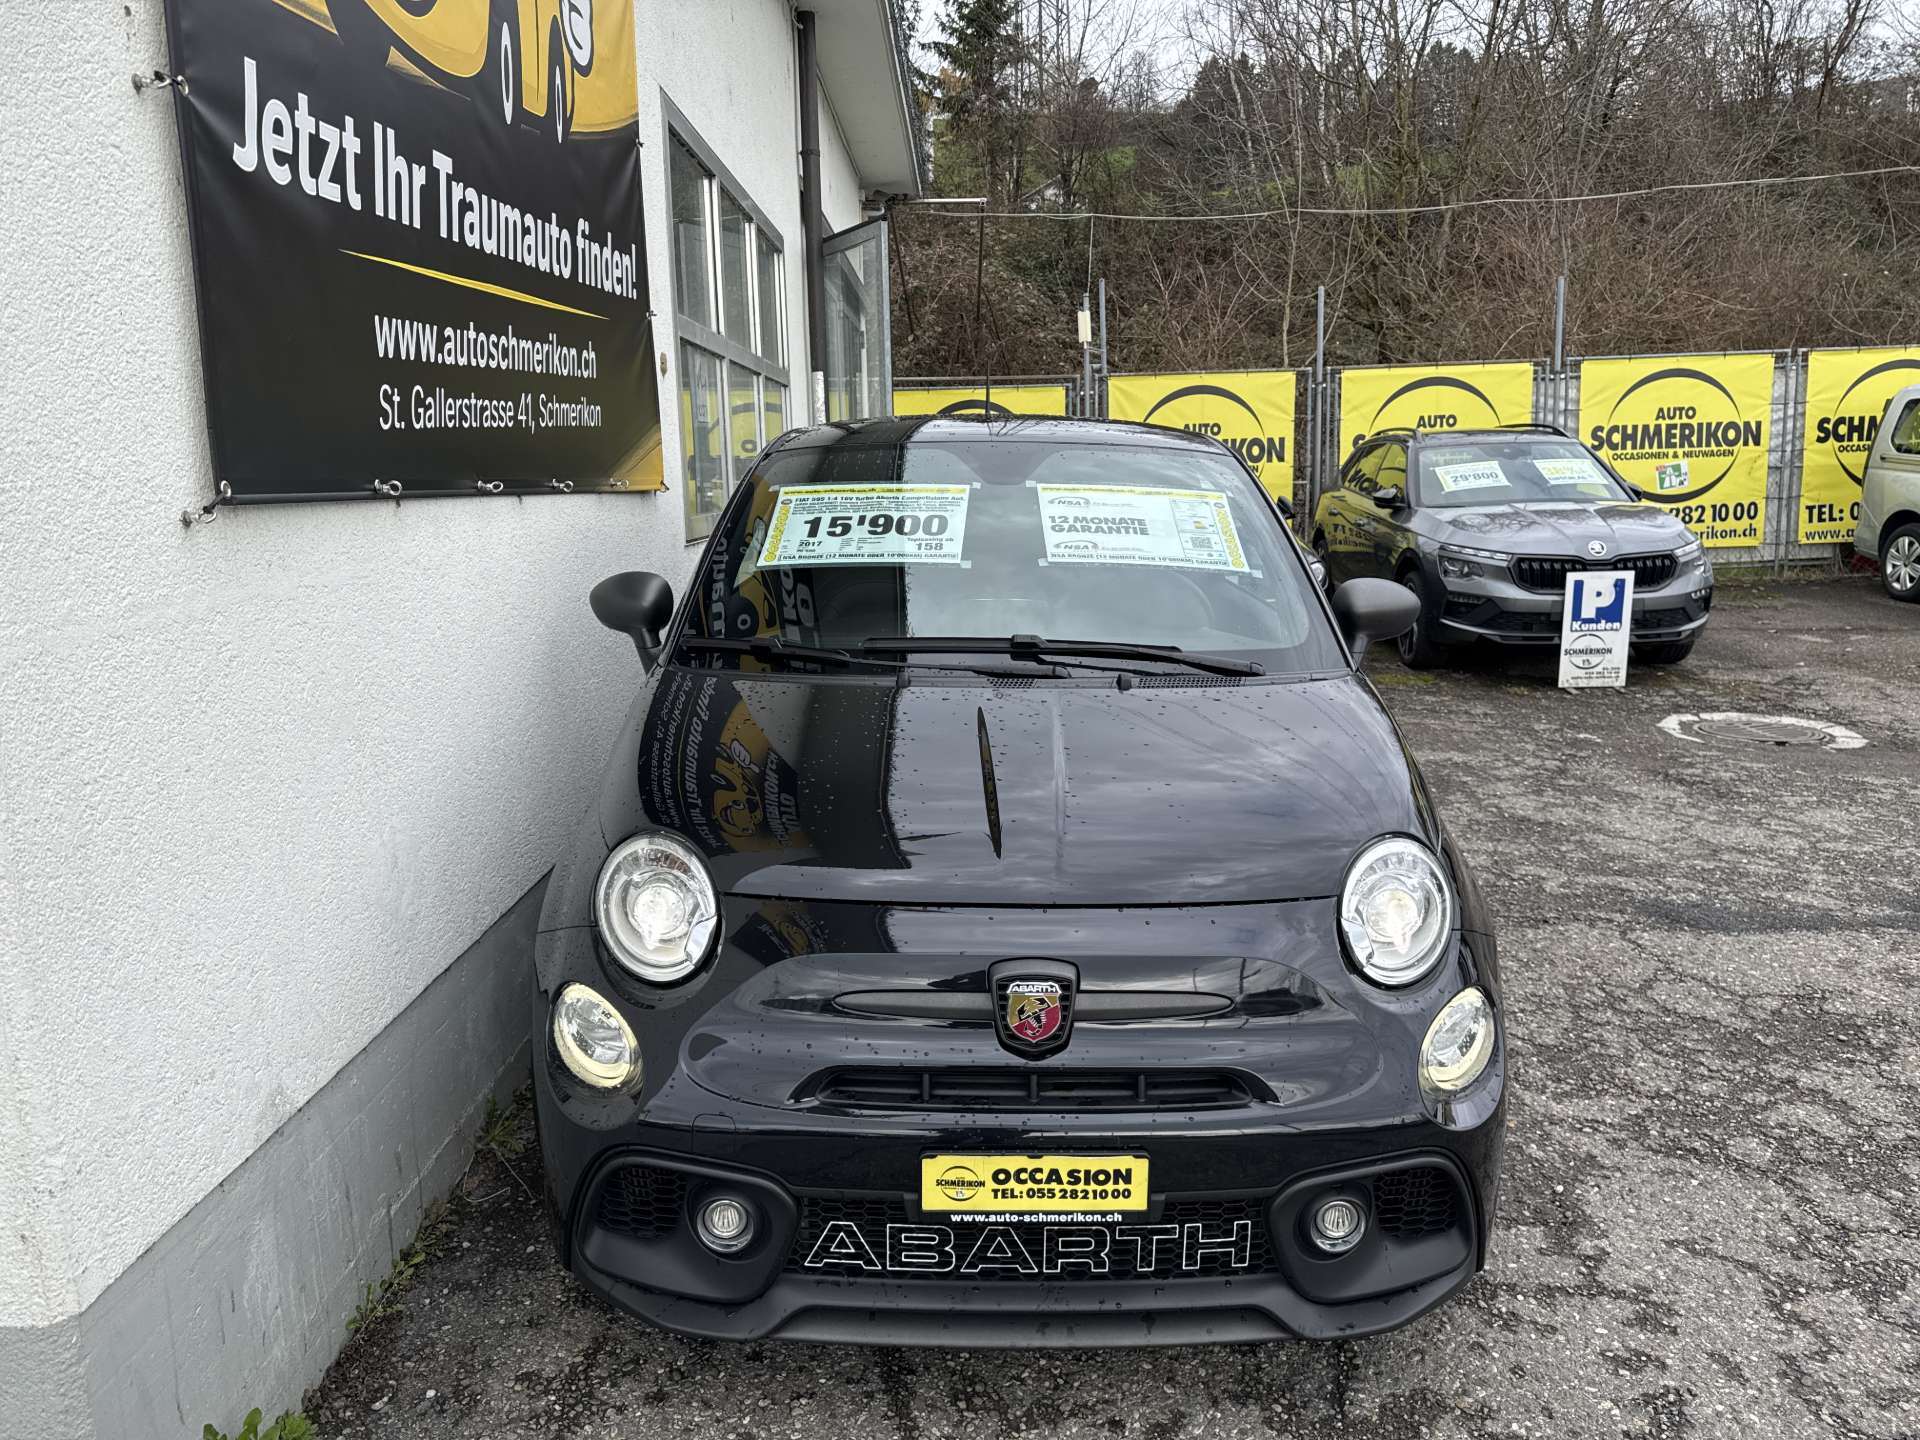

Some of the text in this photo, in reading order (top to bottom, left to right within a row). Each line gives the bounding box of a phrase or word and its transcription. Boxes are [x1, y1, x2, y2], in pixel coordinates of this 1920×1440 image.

[232, 55, 637, 300] Jetzt Ihr Traumauto finden!
[374, 314, 597, 379] www.autoschmerikon.ch
[379, 384, 602, 435] St. Gallerstrasse 41, Schmerikon
[1655, 406, 1697, 421] AUTO
[1416, 414, 1457, 428] AUTO
[1183, 423, 1221, 436] AUTO
[1590, 420, 1762, 450] SCHMERIKON
[1612, 449, 1734, 461] OCCASIONEN & NEUWAGEN
[1449, 471, 1499, 483] 29'800
[1711, 503, 1729, 522] 10
[1733, 501, 1759, 521] 00
[1806, 503, 1844, 524] TEL:
[804, 514, 949, 538] 15'900
[1048, 515, 1147, 526] 12 MONATE
[1051, 524, 1149, 535] GARANTIE
[916, 543, 943, 551] 158
[1581, 576, 1616, 619] P
[1572, 620, 1620, 631] Kunden
[1564, 648, 1612, 656] SCHMERIKON
[936, 1179, 985, 1187] SCHMERIKON
[991, 1168, 1132, 1186] OCCASION
[991, 1188, 1024, 1199] TEL:
[1026, 1188, 1056, 1199] 055
[951, 1213, 1122, 1222] www.auto-schmerikon.ch
[804, 1220, 1251, 1273] ABARTH
